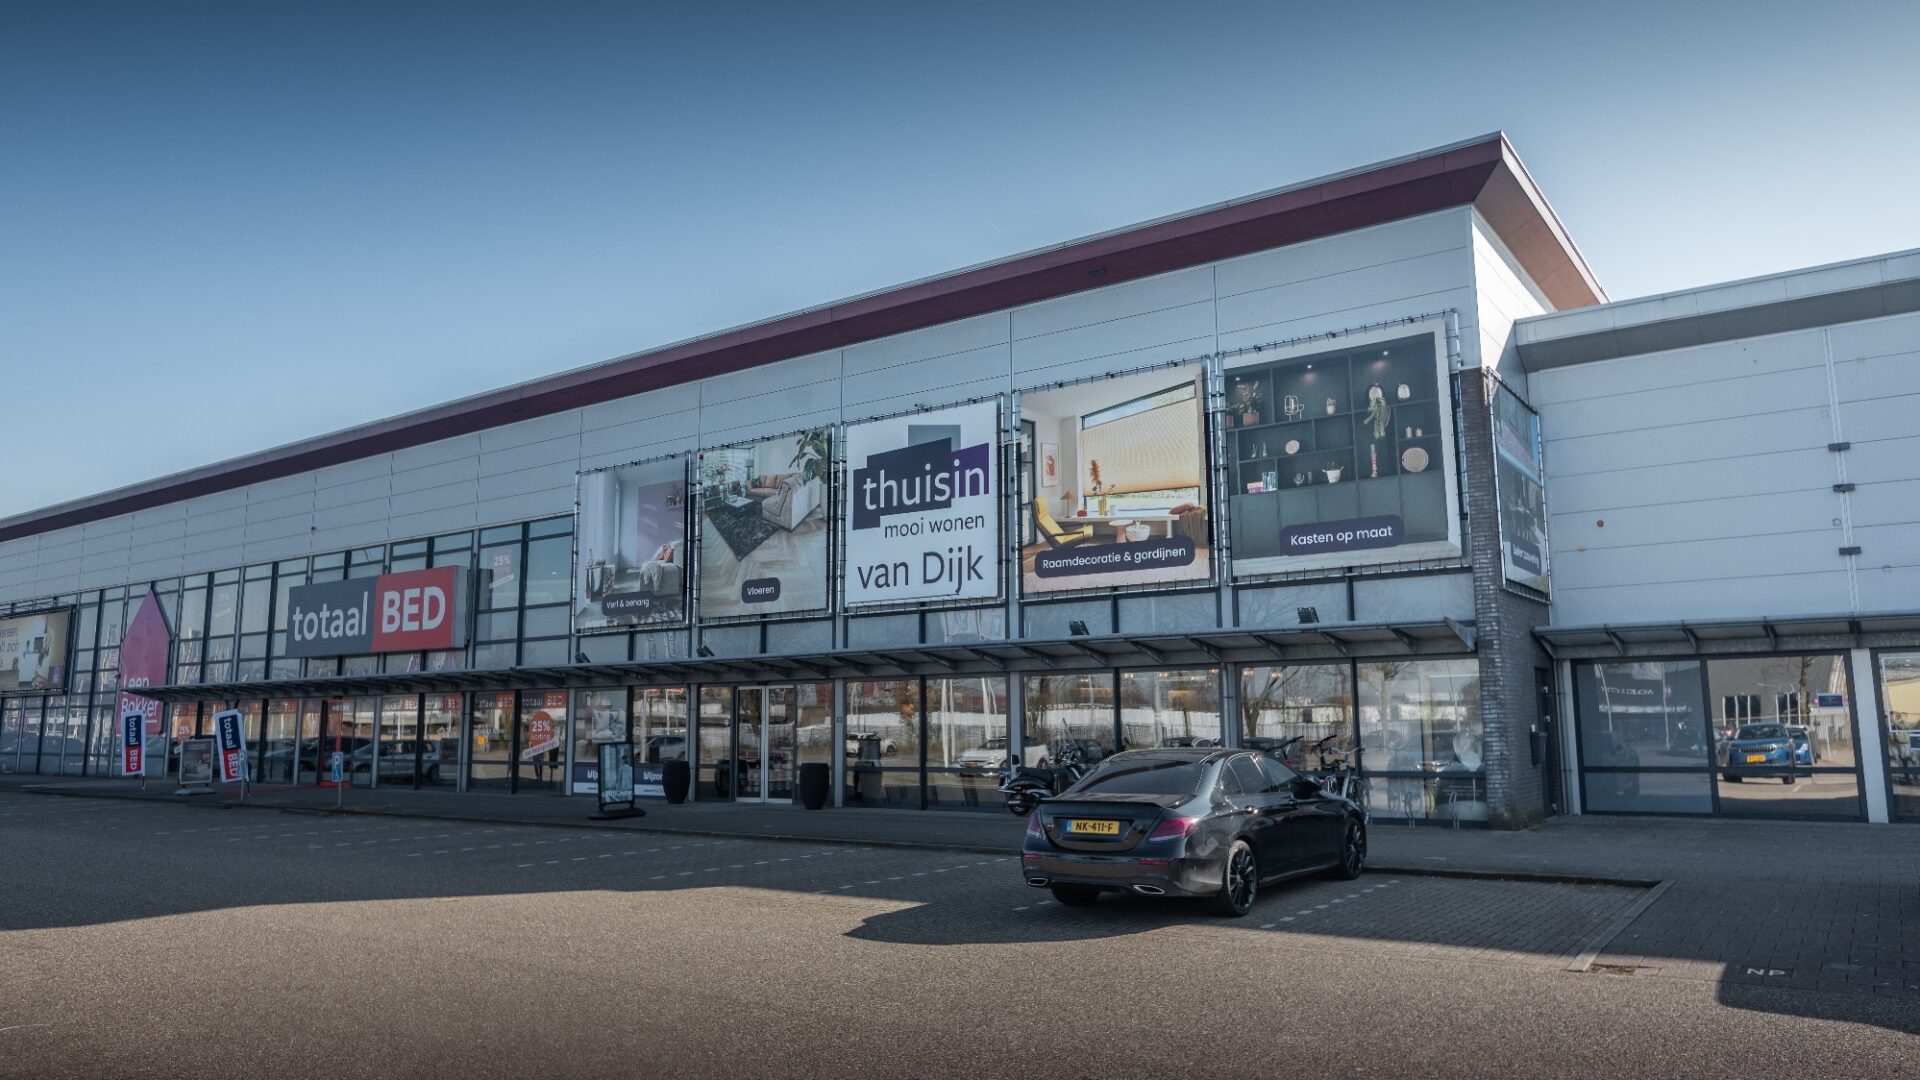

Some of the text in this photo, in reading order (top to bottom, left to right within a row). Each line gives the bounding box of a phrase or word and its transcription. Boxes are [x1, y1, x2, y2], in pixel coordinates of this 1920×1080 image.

[863, 459, 985, 510] thuisin
[884, 514, 985, 538] mooi wonen
[1290, 525, 1393, 546] Kasten op maat
[1042, 547, 1186, 569] Raamdecoratie & gordijnen
[857, 545, 984, 594] van Dijk
[746, 586, 775, 596] Vloeren
[292, 586, 446, 641] totaal BED
[532, 720, 551, 732] 25%
[129, 717, 140, 770] totaal BED
[223, 716, 239, 777] totaal BED
[334, 755, 341, 769] P
[1075, 821, 1113, 832] NK-411-F
[1746, 967, 1786, 977] NP
